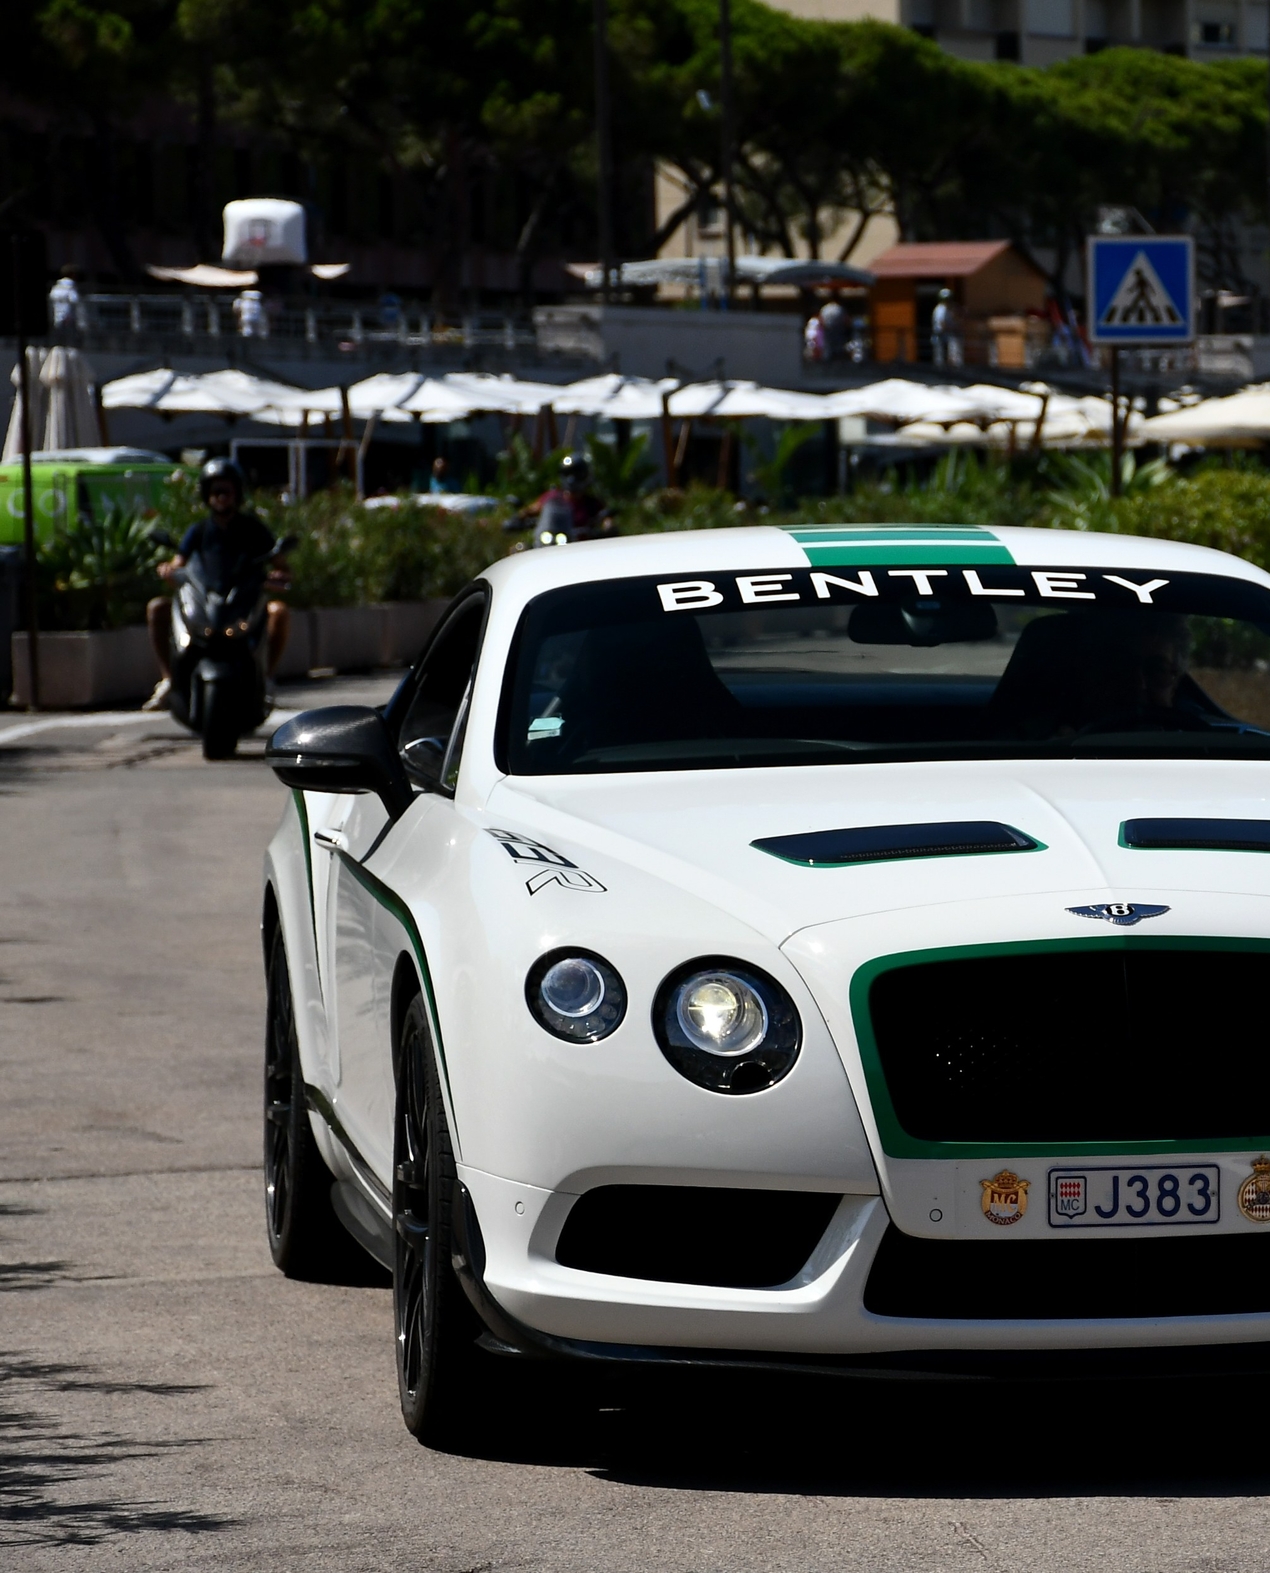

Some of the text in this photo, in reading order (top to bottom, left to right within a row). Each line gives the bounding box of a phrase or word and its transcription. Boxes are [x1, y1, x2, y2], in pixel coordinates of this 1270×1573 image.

[656, 569, 1170, 612] BENTLEY
[1060, 1199, 1080, 1211] MC
[1094, 1173, 1211, 1219] J383
[986, 1211, 1021, 1225] MONACO
